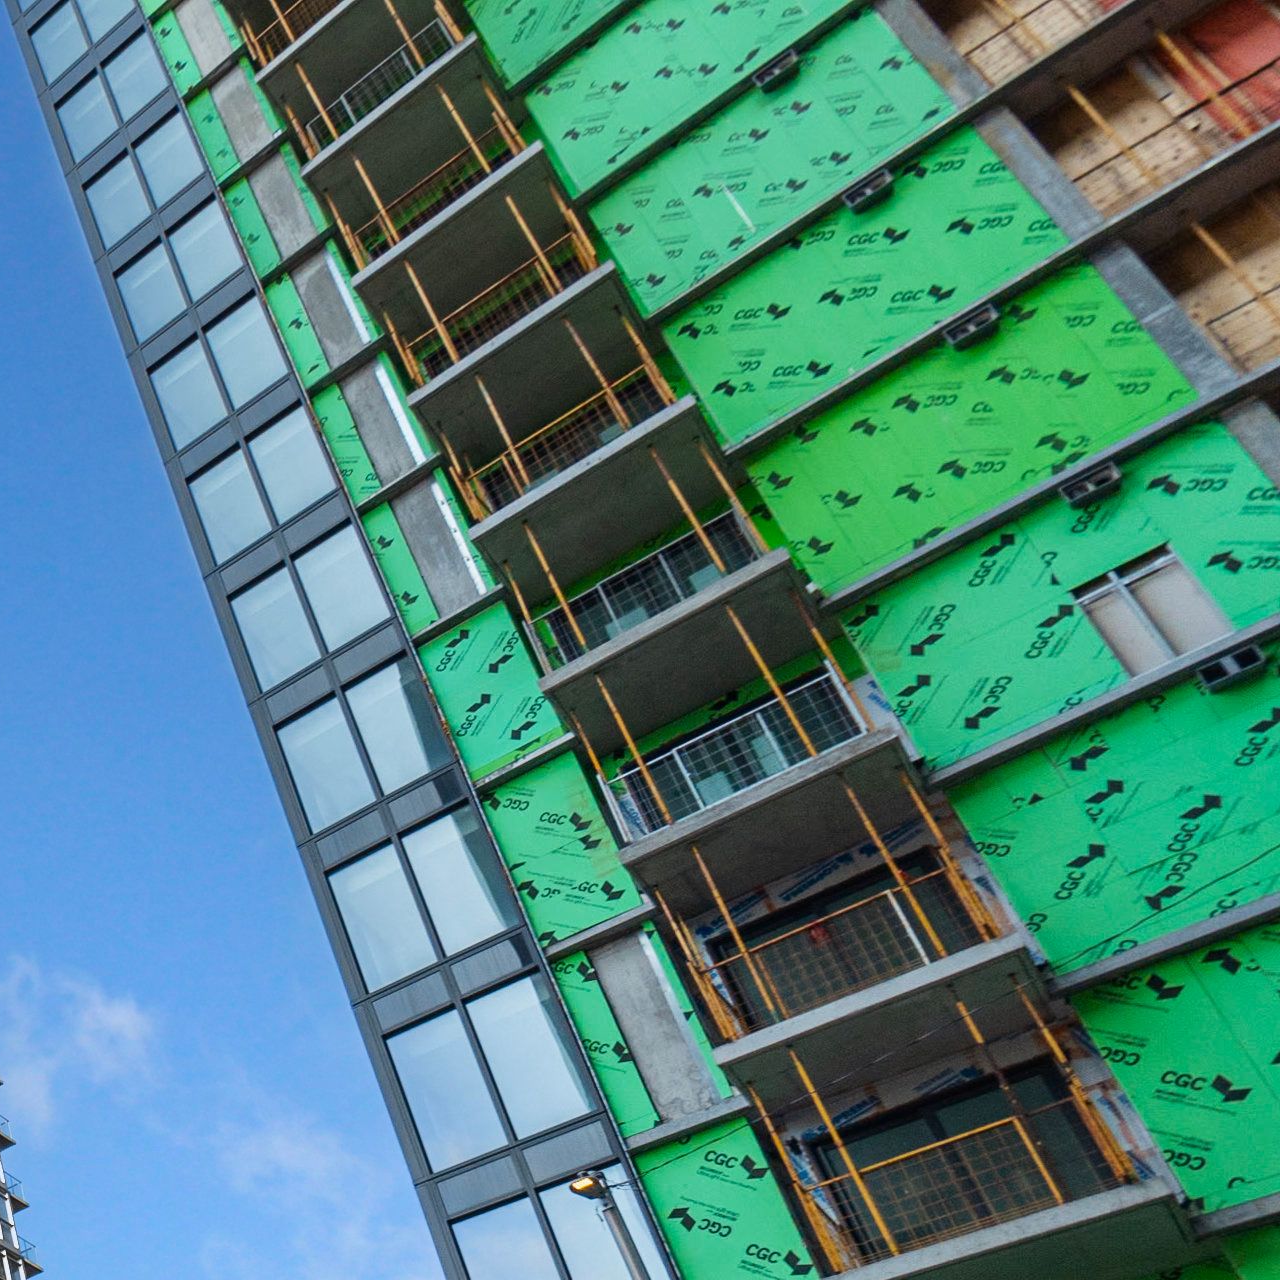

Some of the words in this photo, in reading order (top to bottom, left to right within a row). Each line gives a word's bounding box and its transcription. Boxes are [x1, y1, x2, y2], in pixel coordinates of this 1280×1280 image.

[931, 159, 966, 174] CGC
[977, 215, 1014, 230] CGC
[848, 232, 880, 246] CGC
[890, 290, 925, 302] CGC
[734, 307, 765, 320] CGC
[772, 365, 804, 377] CGC
[922, 394, 958, 409] CGC
[970, 461, 1006, 475] CGC
[1184, 478, 1229, 492] CGC
[968, 559, 997, 587] CGC
[929, 603, 956, 631] CGC
[1024, 631, 1054, 659] CGC
[436, 650, 456, 672] CGC
[983, 675, 1013, 704] CGC
[456, 714, 477, 738] CGC
[1234, 736, 1269, 767] CGC
[502, 798, 530, 811] CGC
[539, 811, 568, 825] CGC
[1167, 823, 1200, 852] CGC
[1165, 852, 1198, 882] CGC
[1054, 871, 1086, 900] CGC
[1160, 1070, 1206, 1091] CGC
[704, 1150, 739, 1169] CGC
[698, 1218, 732, 1238] CGC
[746, 1243, 781, 1264] CGC
